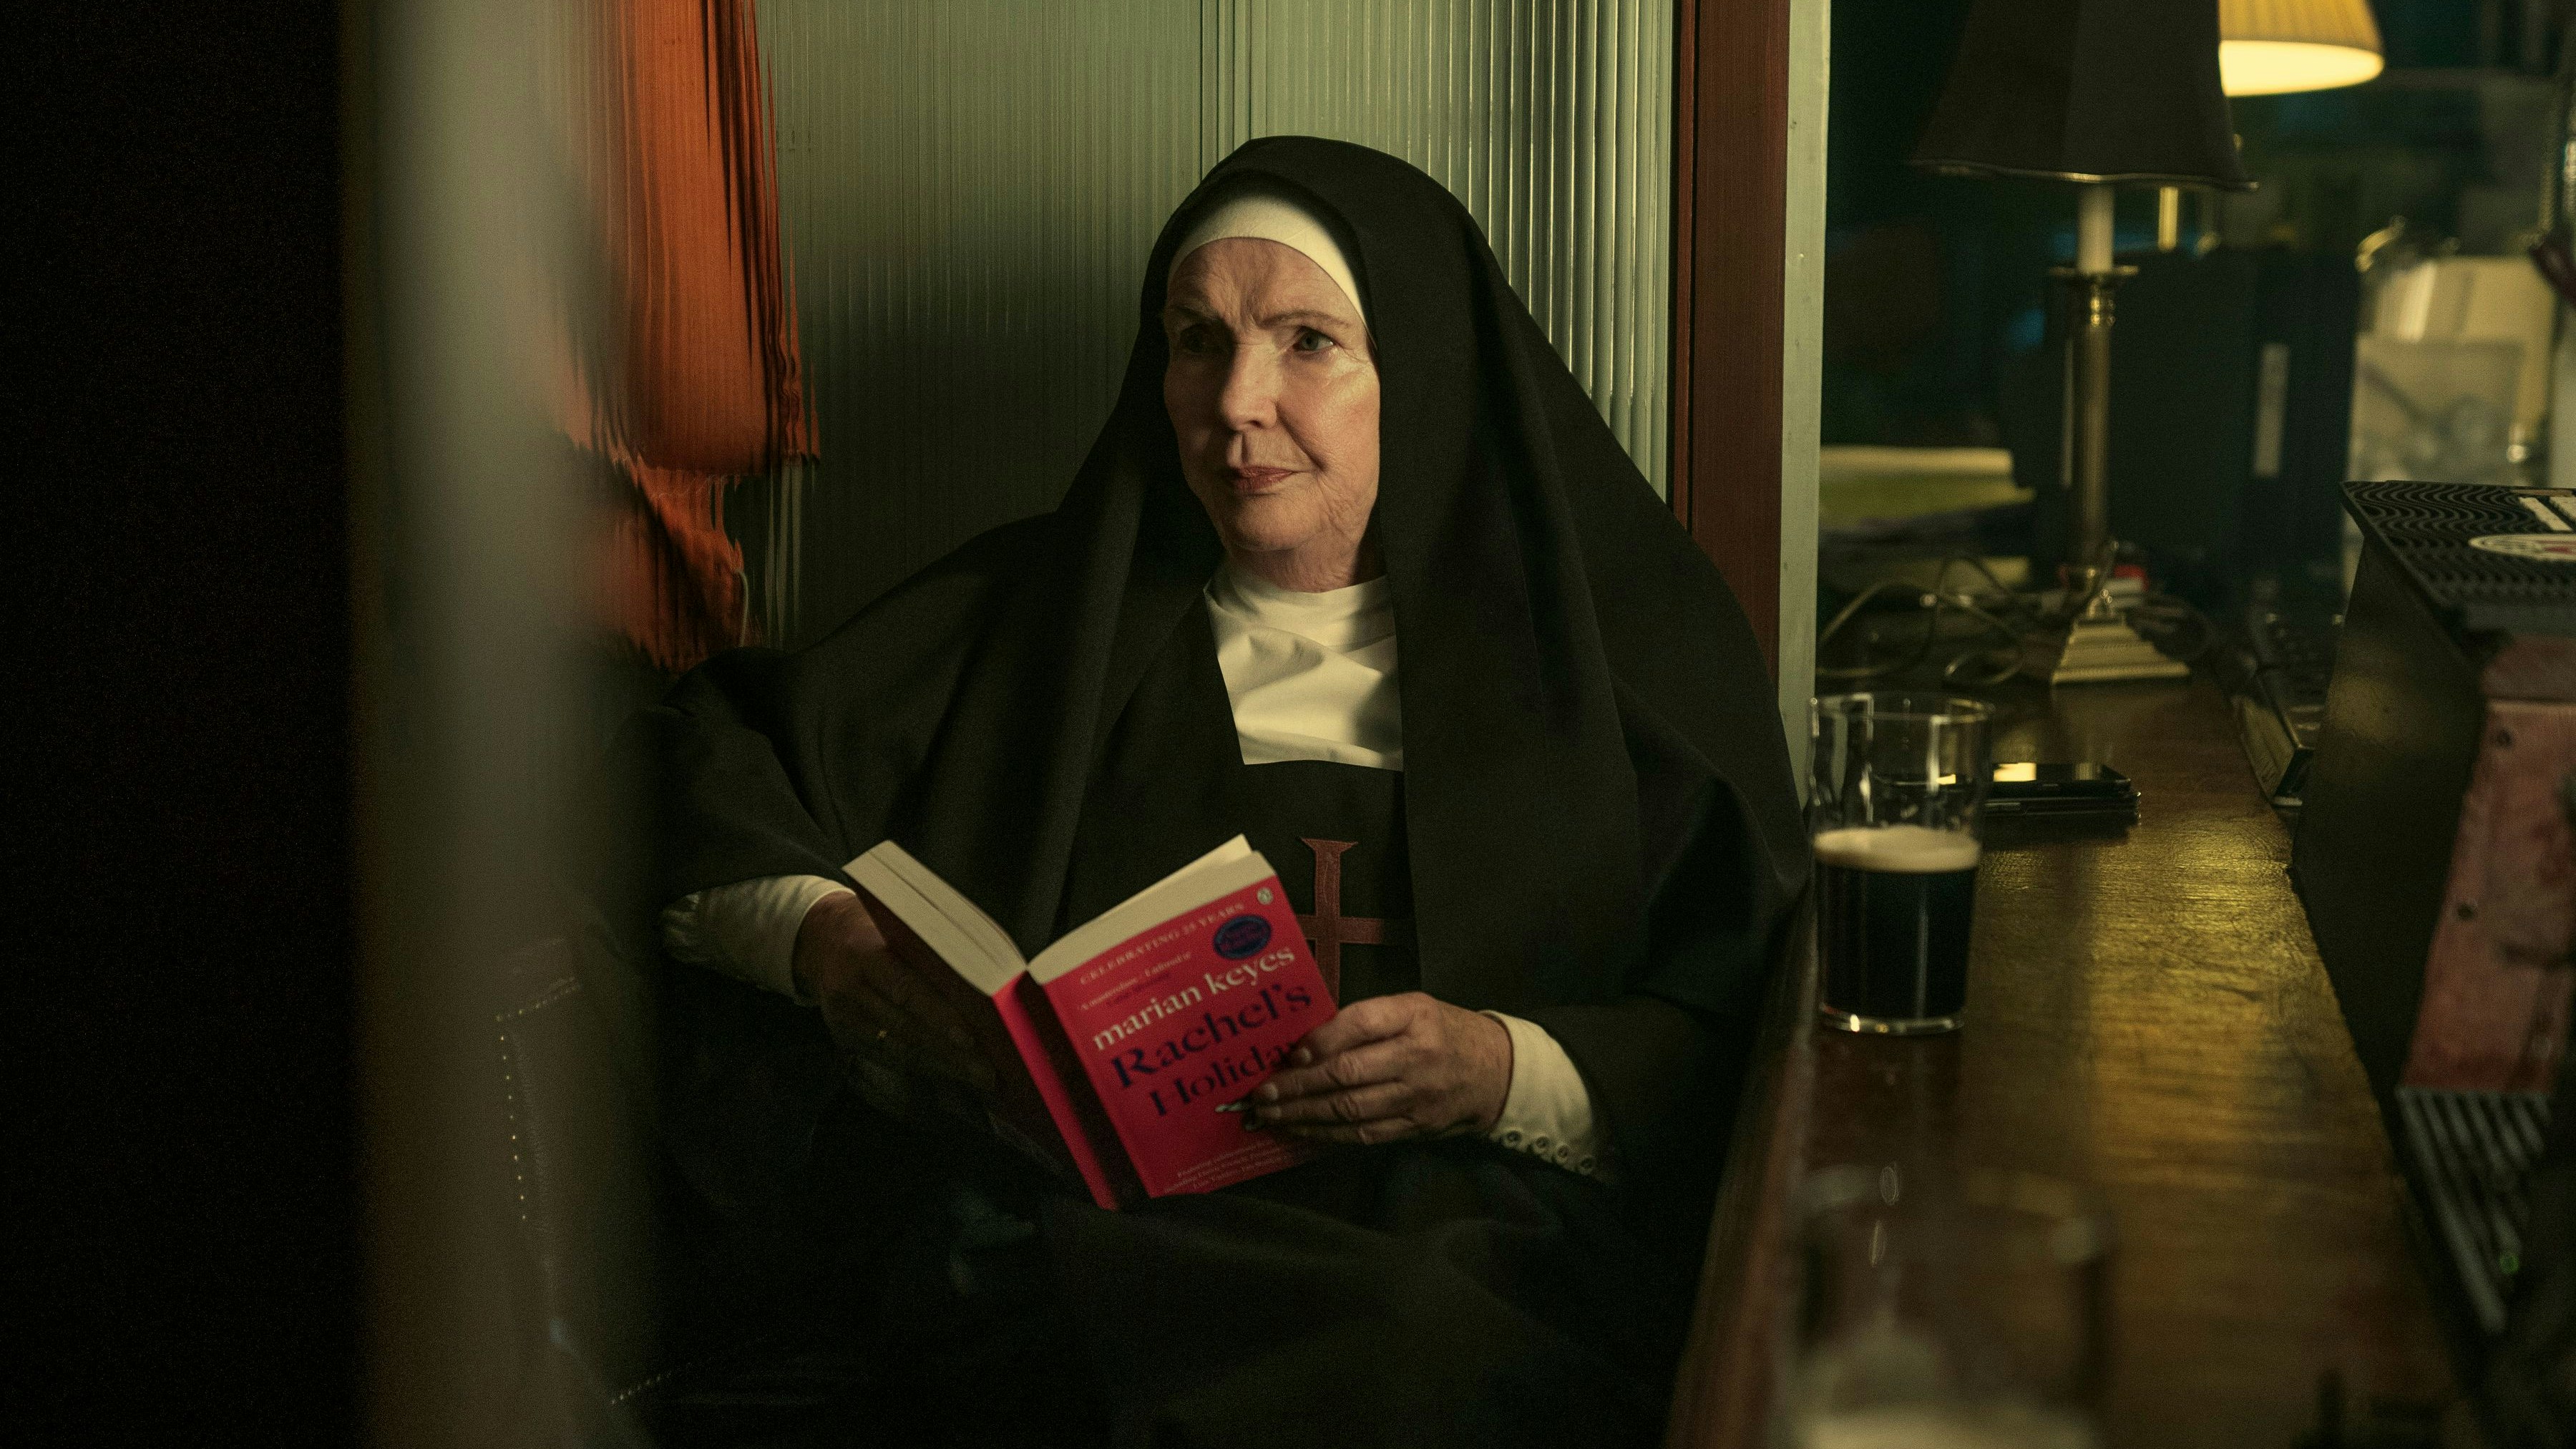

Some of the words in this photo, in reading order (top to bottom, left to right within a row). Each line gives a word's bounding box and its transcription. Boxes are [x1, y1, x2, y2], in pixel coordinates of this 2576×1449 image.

[1079, 932, 1181, 986] CELEBRATING
[1199, 902, 1245, 927] YEARS
[1092, 986, 1203, 1051] marian
[1204, 947, 1295, 995] keyes
